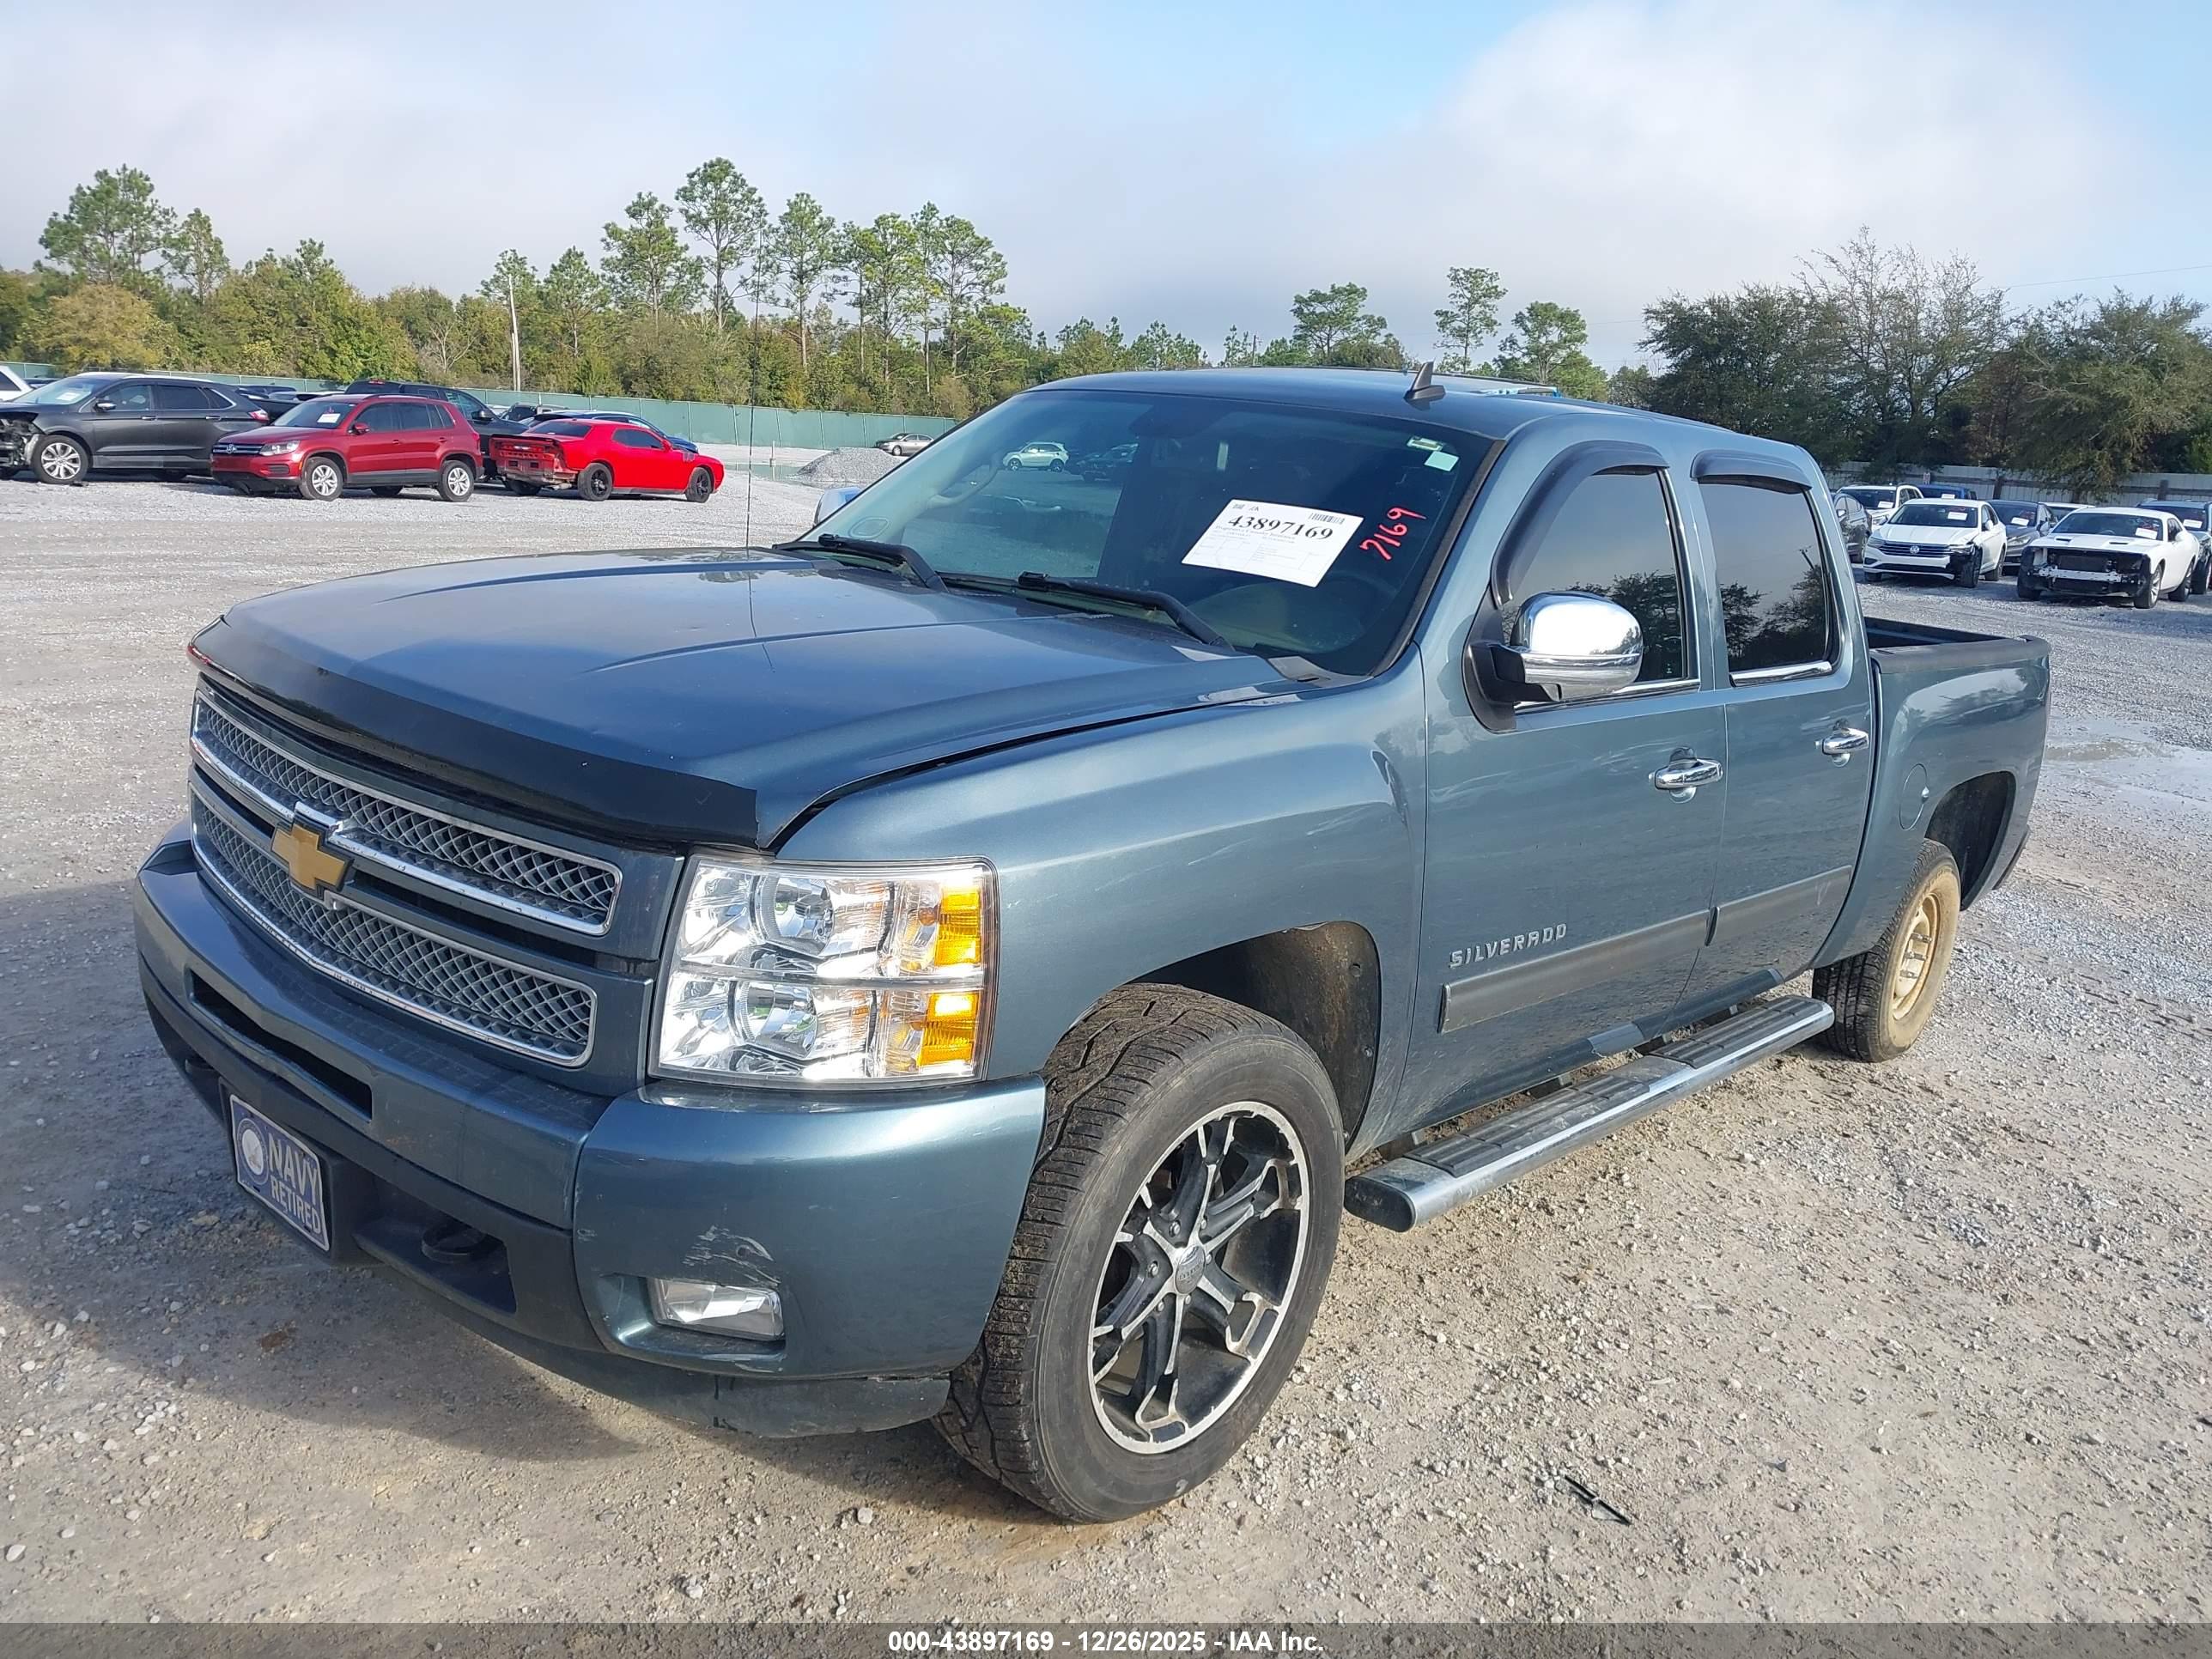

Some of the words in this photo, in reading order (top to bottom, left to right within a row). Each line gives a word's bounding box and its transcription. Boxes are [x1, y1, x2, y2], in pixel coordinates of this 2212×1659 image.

[1229, 515, 1334, 540] 43897169
[1360, 507, 1427, 561] 7169
[1449, 923, 1567, 969] SILVERADO
[268, 1133, 319, 1206] NAVY
[270, 1176, 321, 1234] RETIRED
